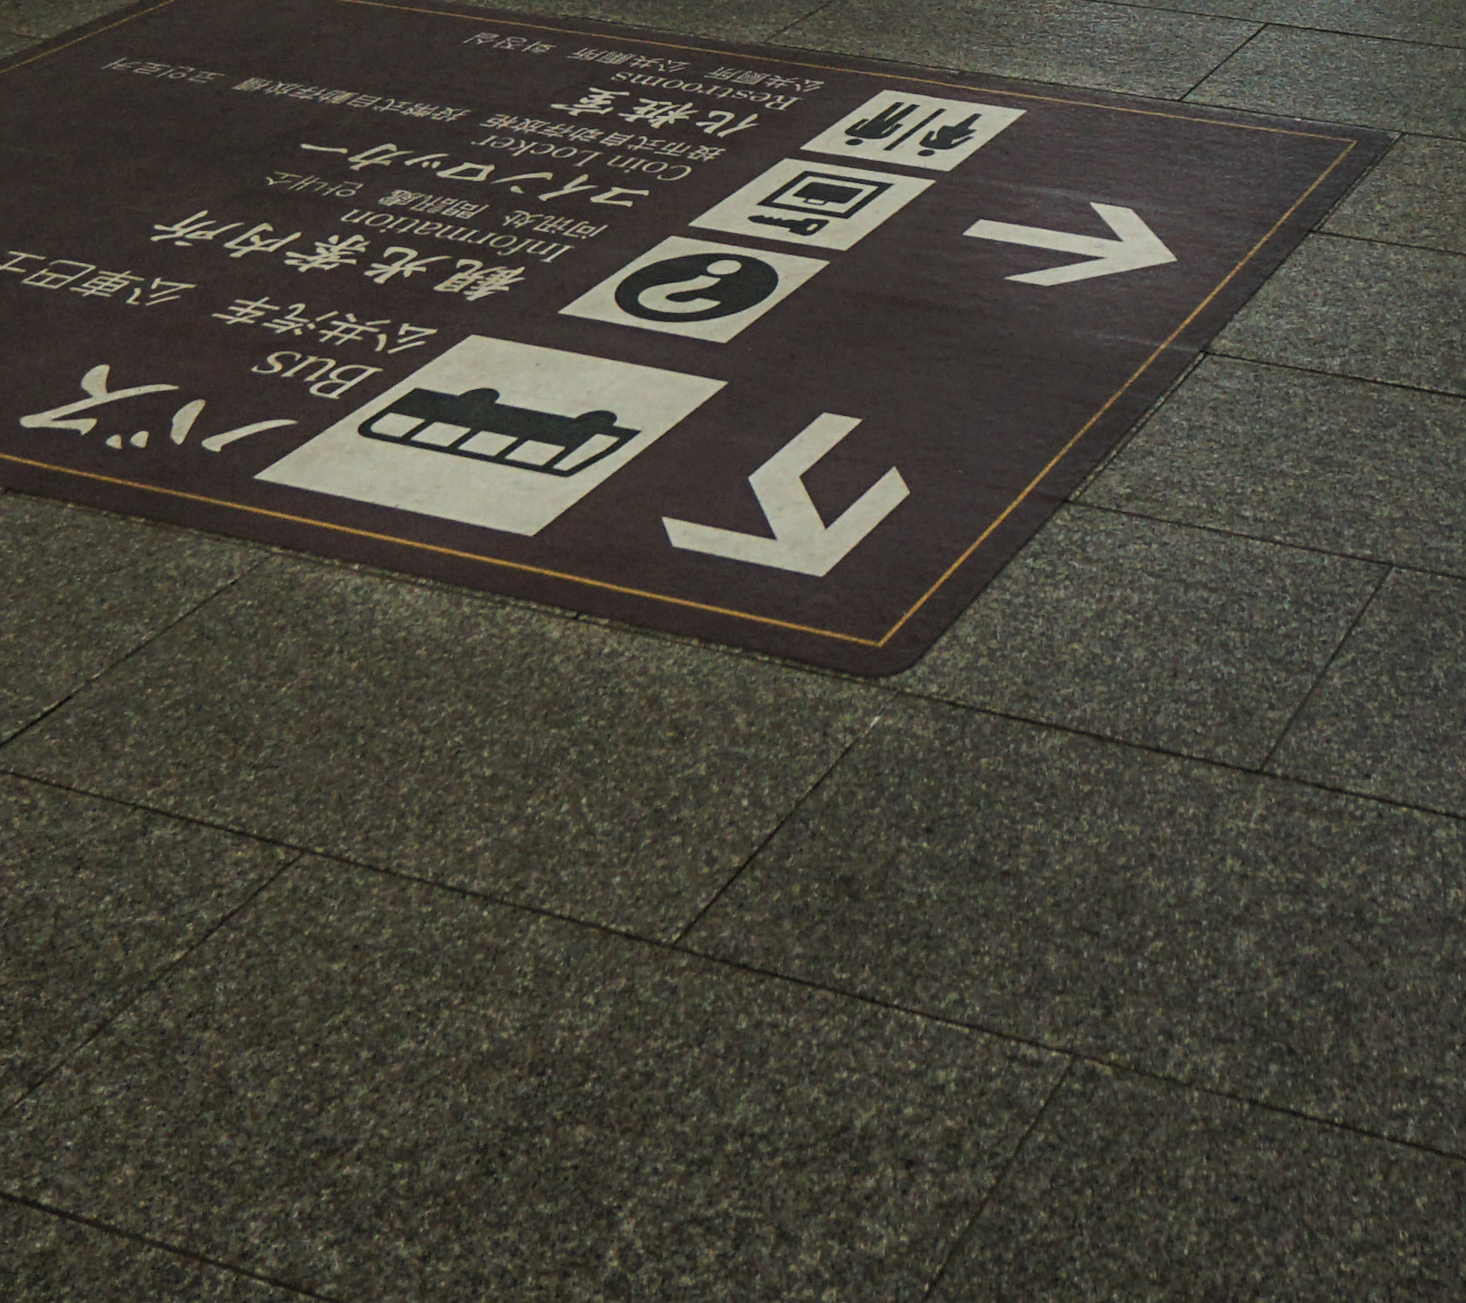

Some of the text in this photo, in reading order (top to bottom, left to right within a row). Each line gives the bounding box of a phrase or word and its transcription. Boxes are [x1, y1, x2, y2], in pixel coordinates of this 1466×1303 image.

[549, 86, 760, 139] 化粧室
[609, 70, 803, 111] Restrooms
[298, 141, 650, 208] コインロッカー
[470, 132, 694, 182] Coin Locker
[149, 209, 527, 303] 観光案内所
[339, 207, 570, 257] Information
[210, 295, 438, 355] 公共汽车
[250, 349, 385, 400] Bus
[18, 364, 299, 454] バス
